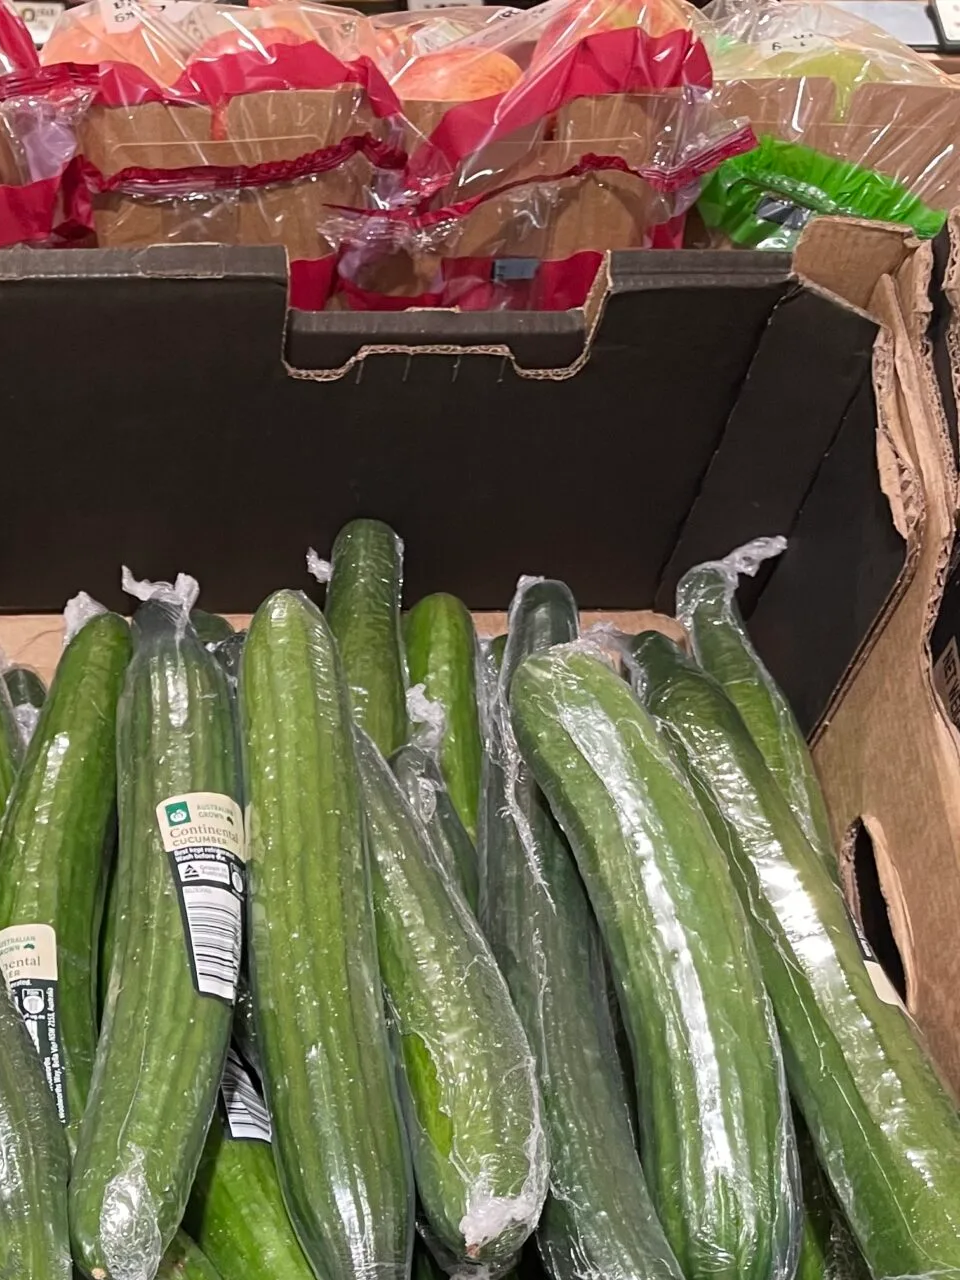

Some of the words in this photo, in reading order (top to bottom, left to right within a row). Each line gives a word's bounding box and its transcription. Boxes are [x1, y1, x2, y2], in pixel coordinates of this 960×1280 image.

[197, 804, 234, 816] AUSTRALIAN
[199, 811, 224, 819] GROWN
[170, 824, 239, 844] Continental
[173, 836, 227, 846] CUCUMBER
[46, 987, 54, 1011] Australia
